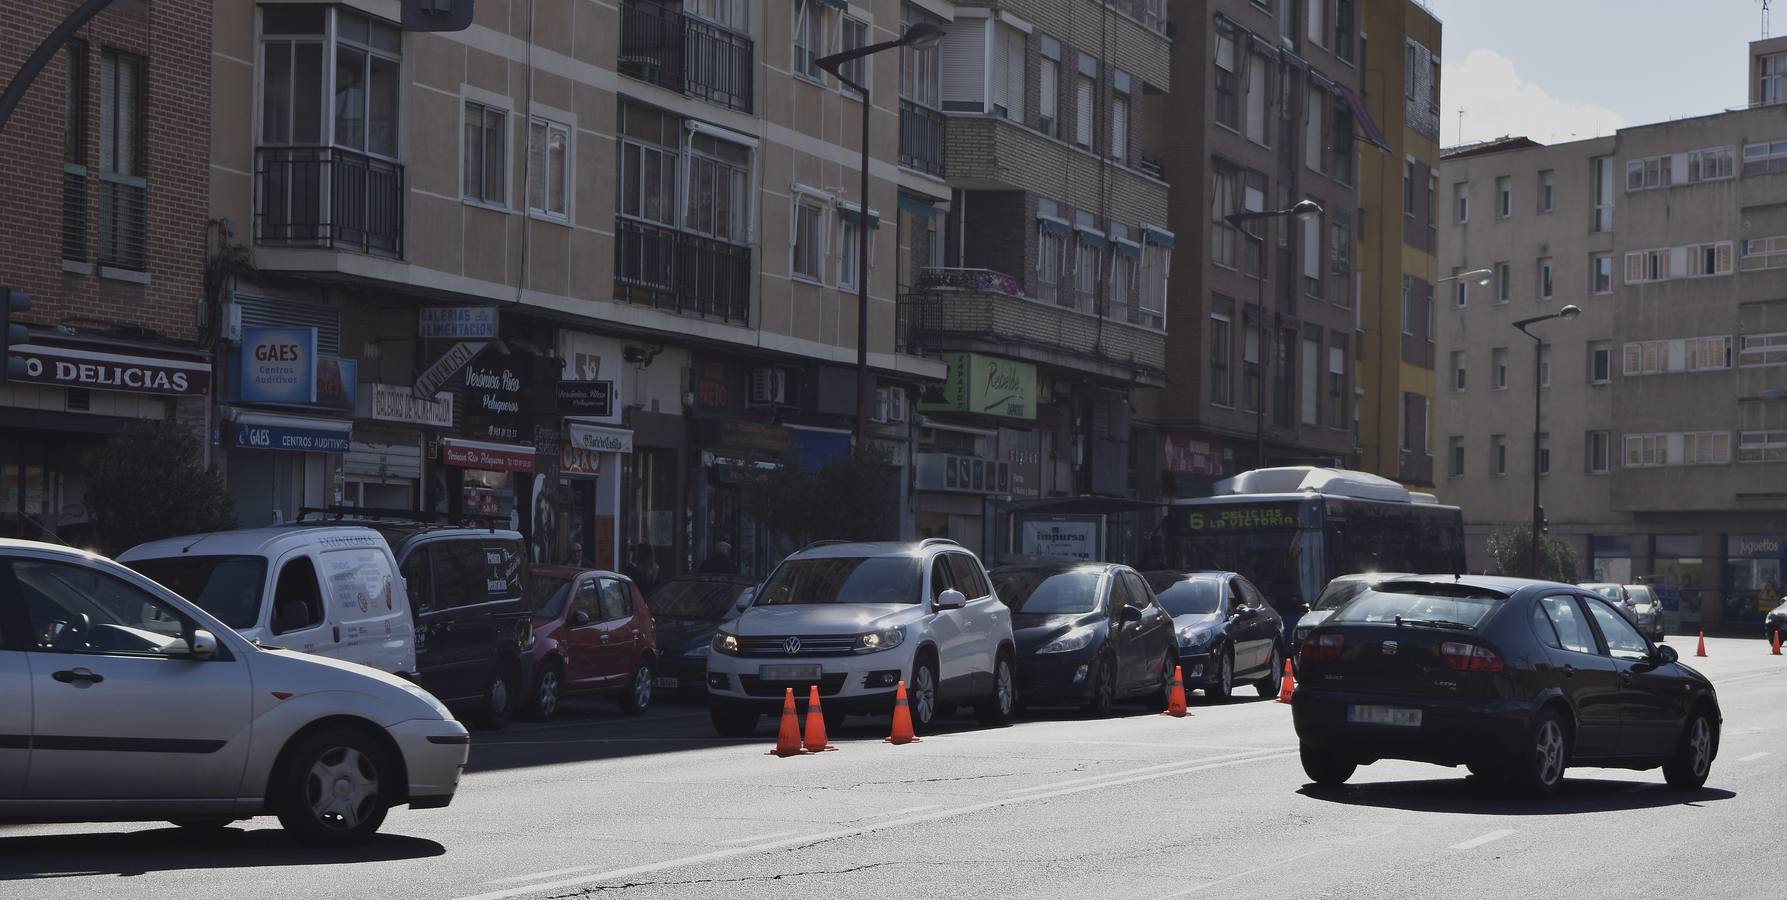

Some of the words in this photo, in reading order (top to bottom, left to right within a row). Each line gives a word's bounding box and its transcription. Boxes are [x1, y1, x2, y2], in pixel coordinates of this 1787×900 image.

[256, 344, 298, 361] GAES
[56, 362, 188, 391] DELICIAS
[259, 366, 294, 374] Centros
[465, 365, 500, 390] Verónica
[502, 369, 520, 392] Rico
[255, 376, 297, 384] Auditivos
[482, 393, 519, 414] Peluqueros
[249, 429, 270, 446] GAES
[282, 435, 312, 448] CENTROS
[314, 439, 349, 449] AUDITIVOS
[1190, 513, 1204, 530] 6
[1222, 509, 1281, 520] DELICIAS
[1210, 519, 1226, 529] LA
[1230, 516, 1293, 527] VICTORIA
[1037, 531, 1085, 543] impursa
